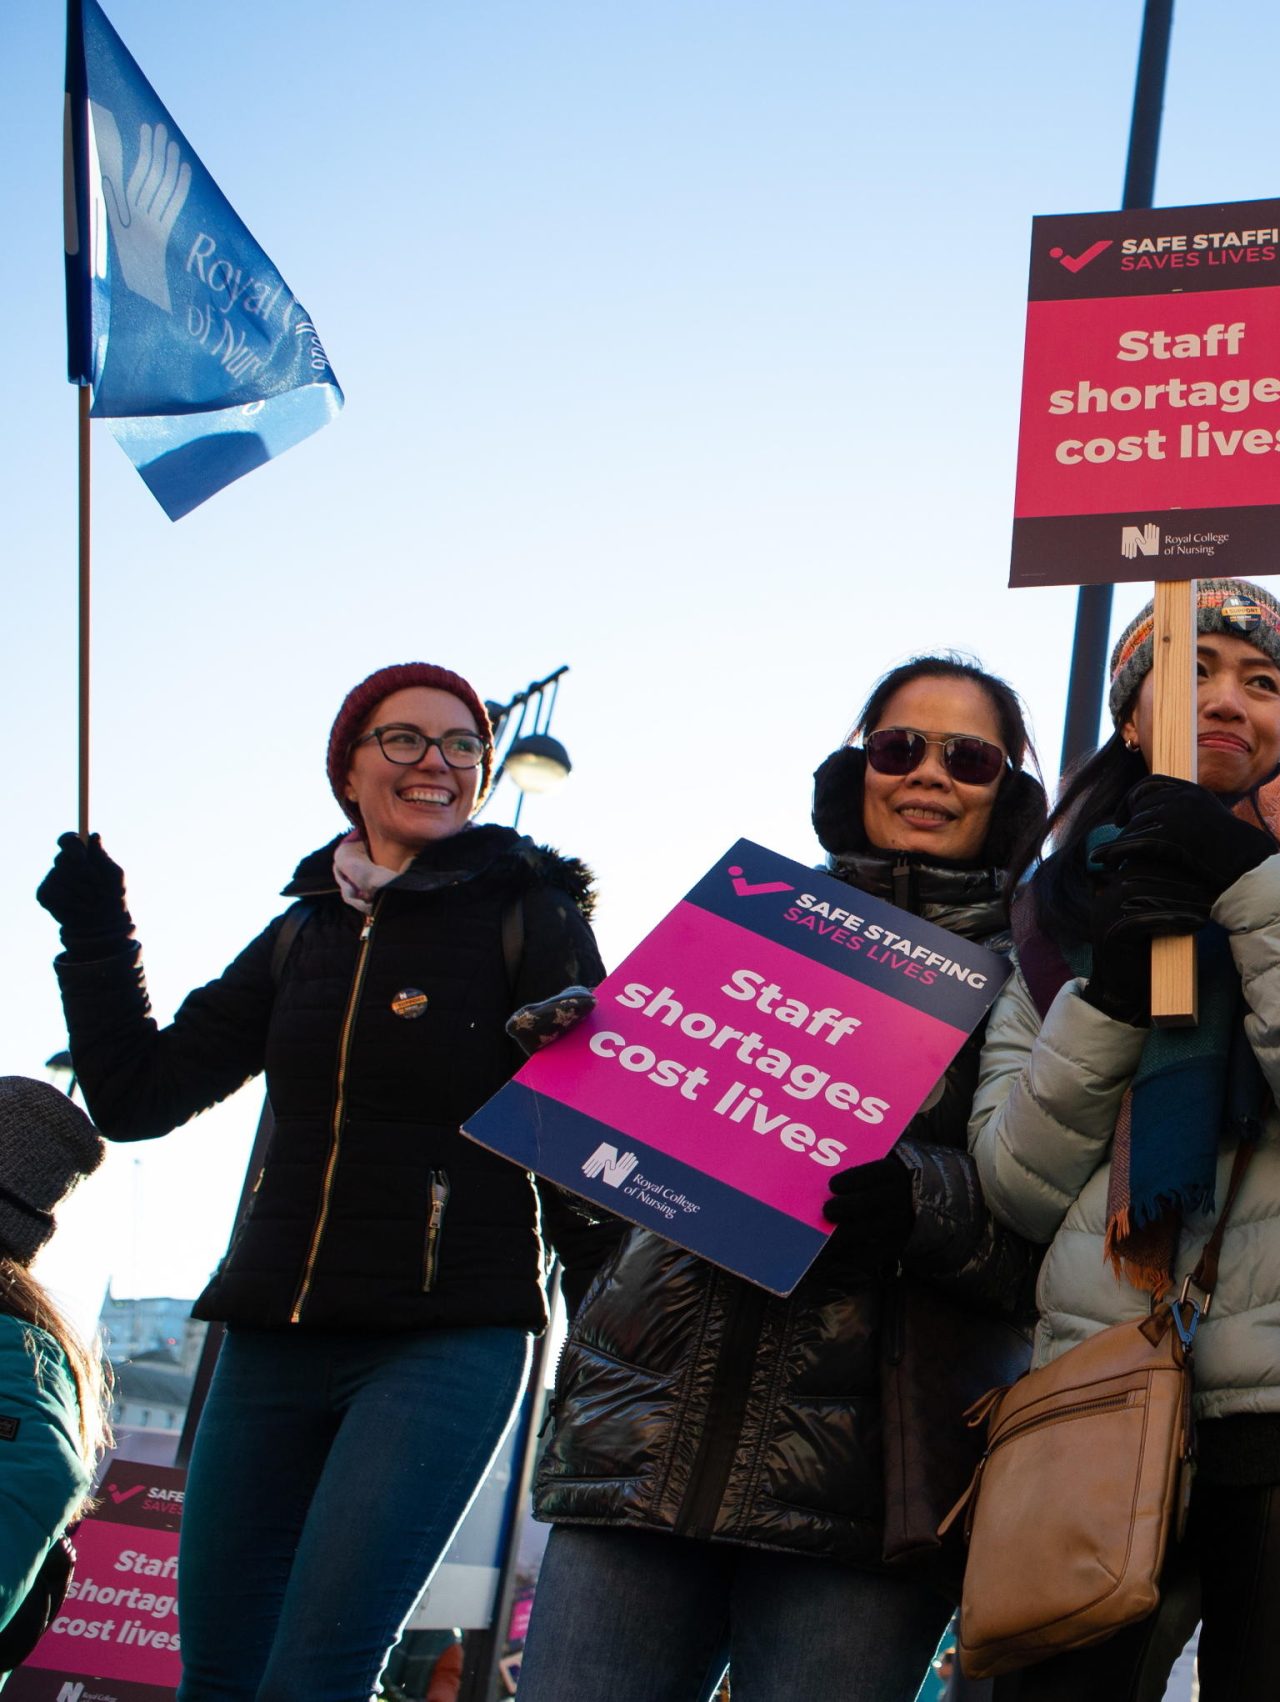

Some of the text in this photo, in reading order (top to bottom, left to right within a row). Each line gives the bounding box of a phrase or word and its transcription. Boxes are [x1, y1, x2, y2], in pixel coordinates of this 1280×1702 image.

[1120, 235, 1187, 255] SAFE
[1120, 246, 1276, 271] SAVES LIVES
[186, 232, 285, 320] Royal
[1116, 322, 1246, 362] Staff
[1055, 429, 1166, 465] cost
[1164, 532, 1230, 546] Royal College
[1164, 545, 1215, 556] of Nursing
[783, 906, 937, 985] SAVES LIVES
[795, 893, 988, 989] SAFE STAFFING
[721, 968, 861, 1046] Staff
[615, 981, 891, 1125] shortages
[588, 1031, 847, 1167] cost lives
[623, 1186, 677, 1219] of Nursing
[632, 1173, 701, 1213] Royal College
[147, 1487, 185, 1502] SAFE
[66, 1578, 178, 1618] shortag
[51, 1616, 181, 1651] cost lives
